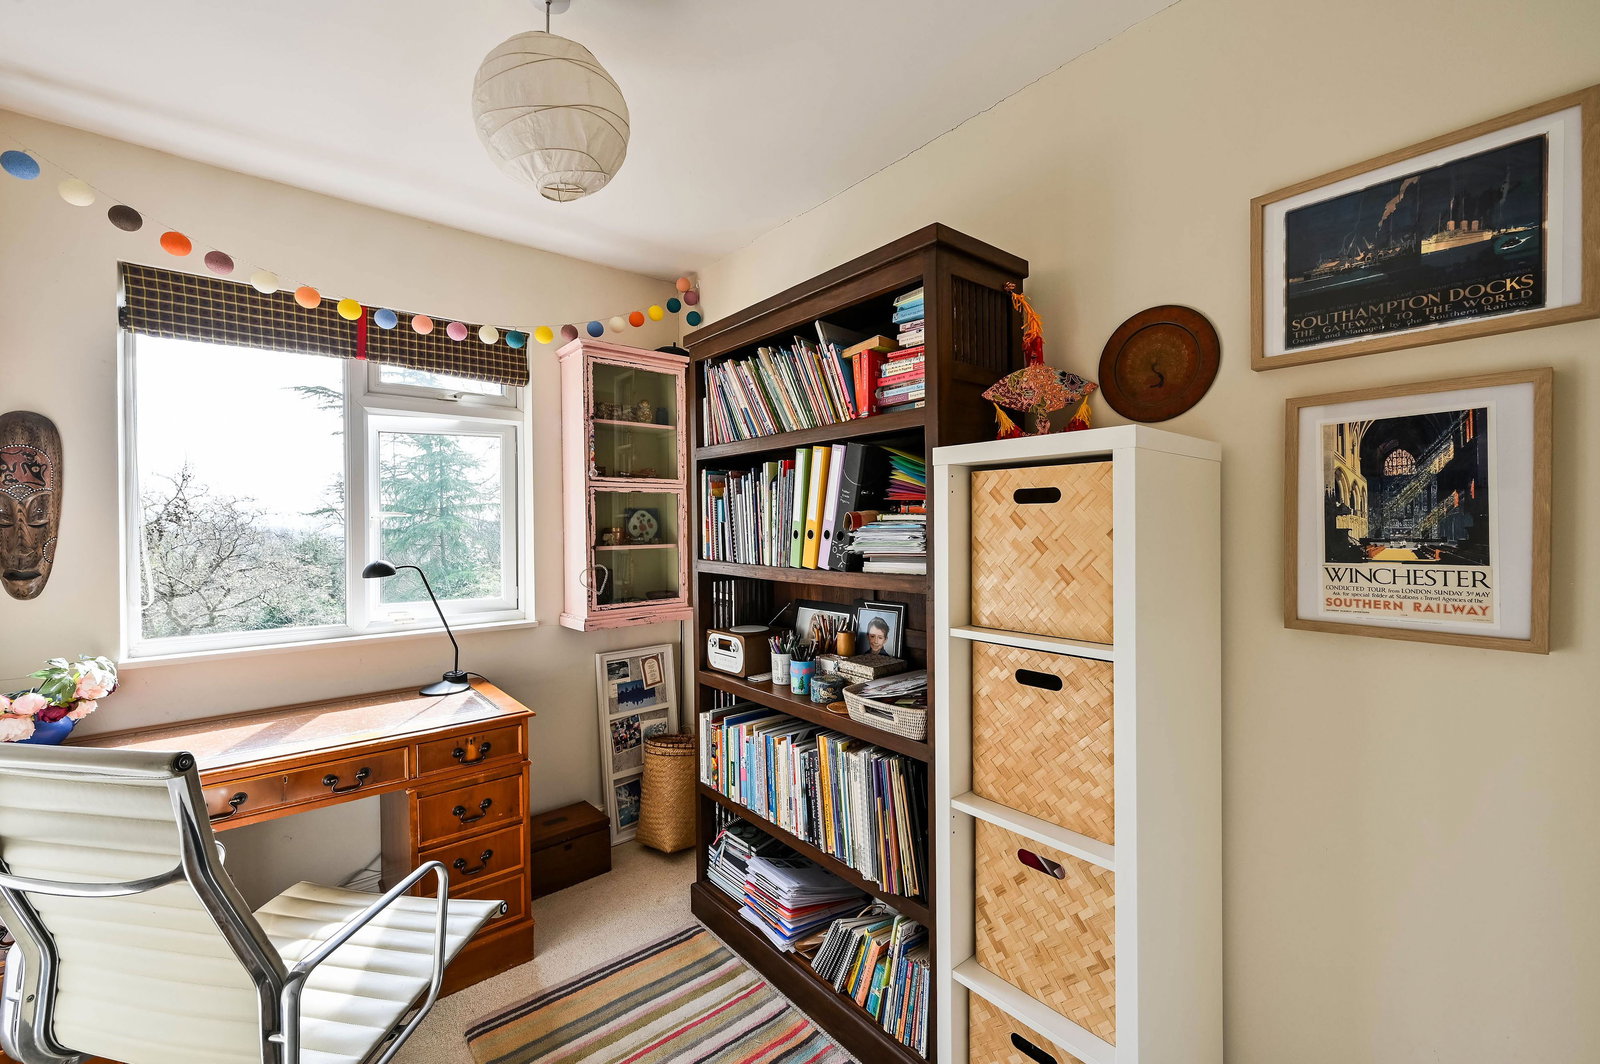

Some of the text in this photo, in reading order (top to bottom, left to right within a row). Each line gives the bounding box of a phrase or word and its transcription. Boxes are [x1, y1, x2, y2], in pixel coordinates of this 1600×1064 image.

[1292, 274, 1534, 331] SOUTHAMPTON DOCKS
[1292, 289, 1533, 339] THE GATEWAY TO THE WORLD
[1292, 334, 1321, 345] Owned
[1324, 331, 1341, 340] and
[1345, 324, 1385, 337] Managed
[1389, 321, 1401, 329] by
[1429, 308, 1478, 321] Southern
[1324, 567, 1491, 589] WINCHESTER
[1325, 597, 1491, 616] SOUTHERN RAILWAY
